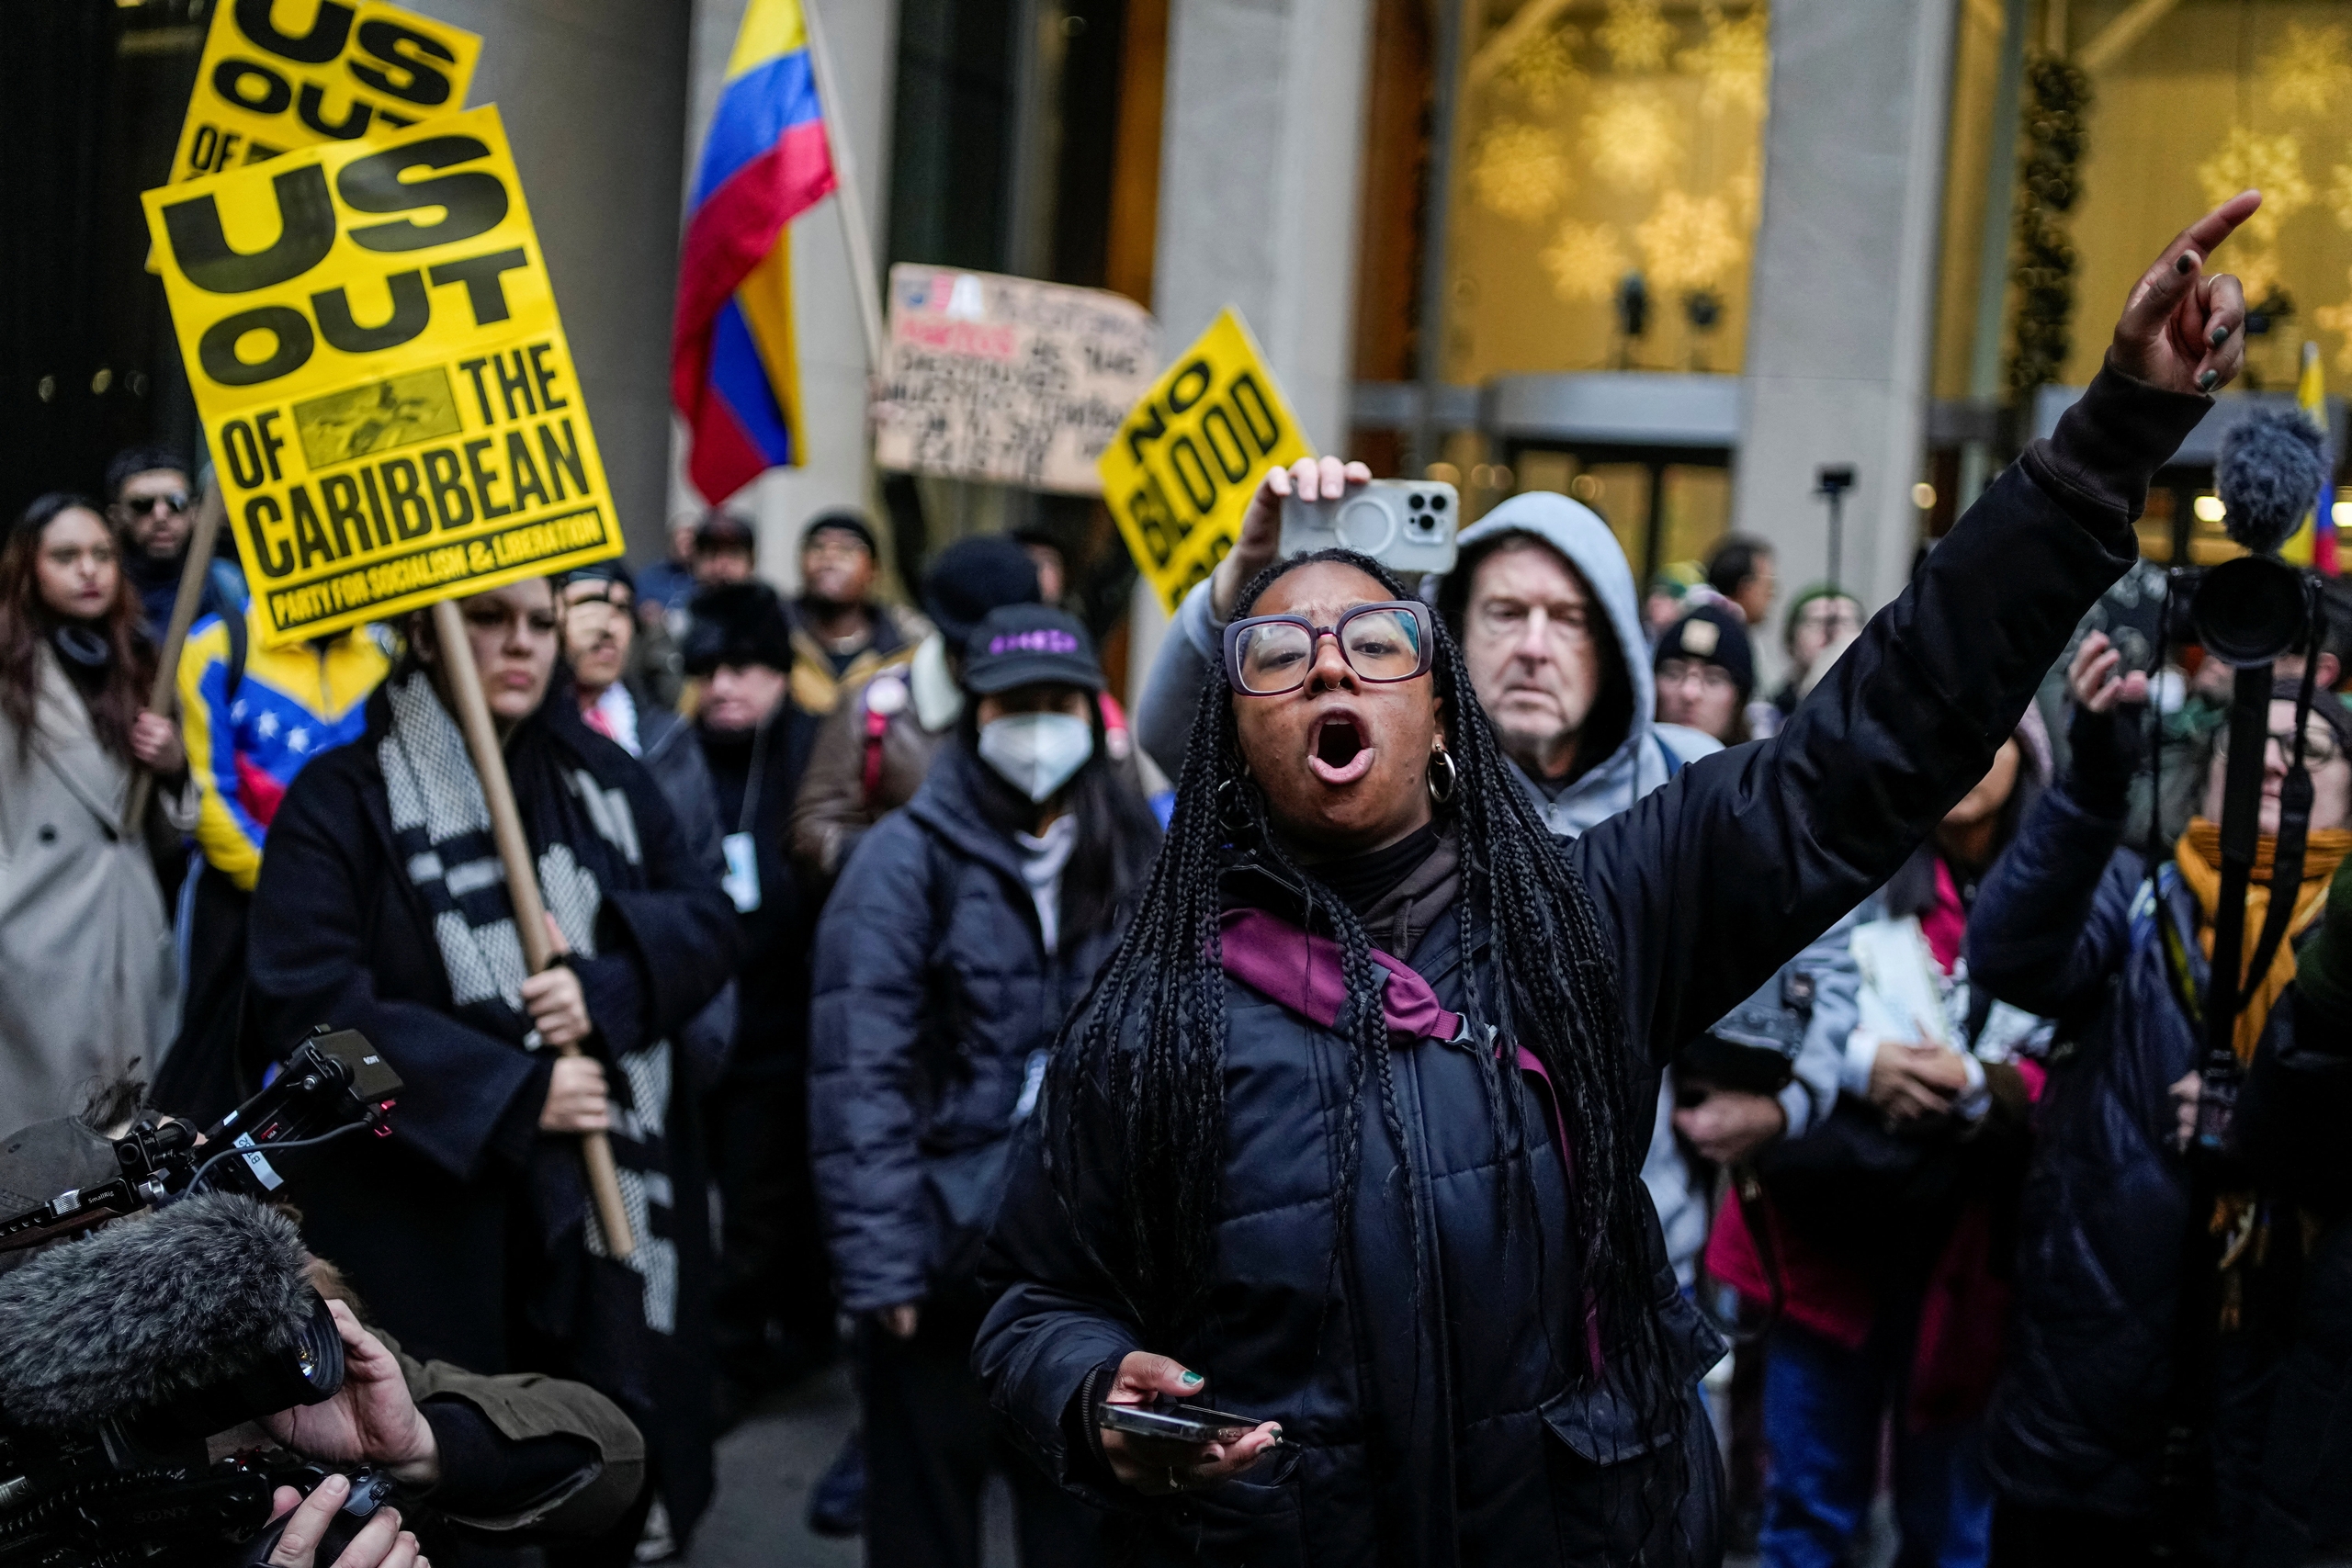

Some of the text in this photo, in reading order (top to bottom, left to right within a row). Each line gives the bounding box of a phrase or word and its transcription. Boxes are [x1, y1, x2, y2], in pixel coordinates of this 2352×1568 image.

[233, 0, 456, 106] US
[191, 125, 242, 174] OF
[161, 135, 508, 294] US
[198, 247, 529, 387] OUT
[220, 343, 568, 491] OF THE
[1125, 360, 1211, 464] NO
[243, 420, 590, 579] CARIBBEAN
[1129, 374, 1280, 570] BLOOD
[272, 511, 604, 627] PARTY FOR SOCIALISM & LIBERATION
[87, 1190, 115, 1204] SmallRig
[132, 1504, 193, 1524] SONY
